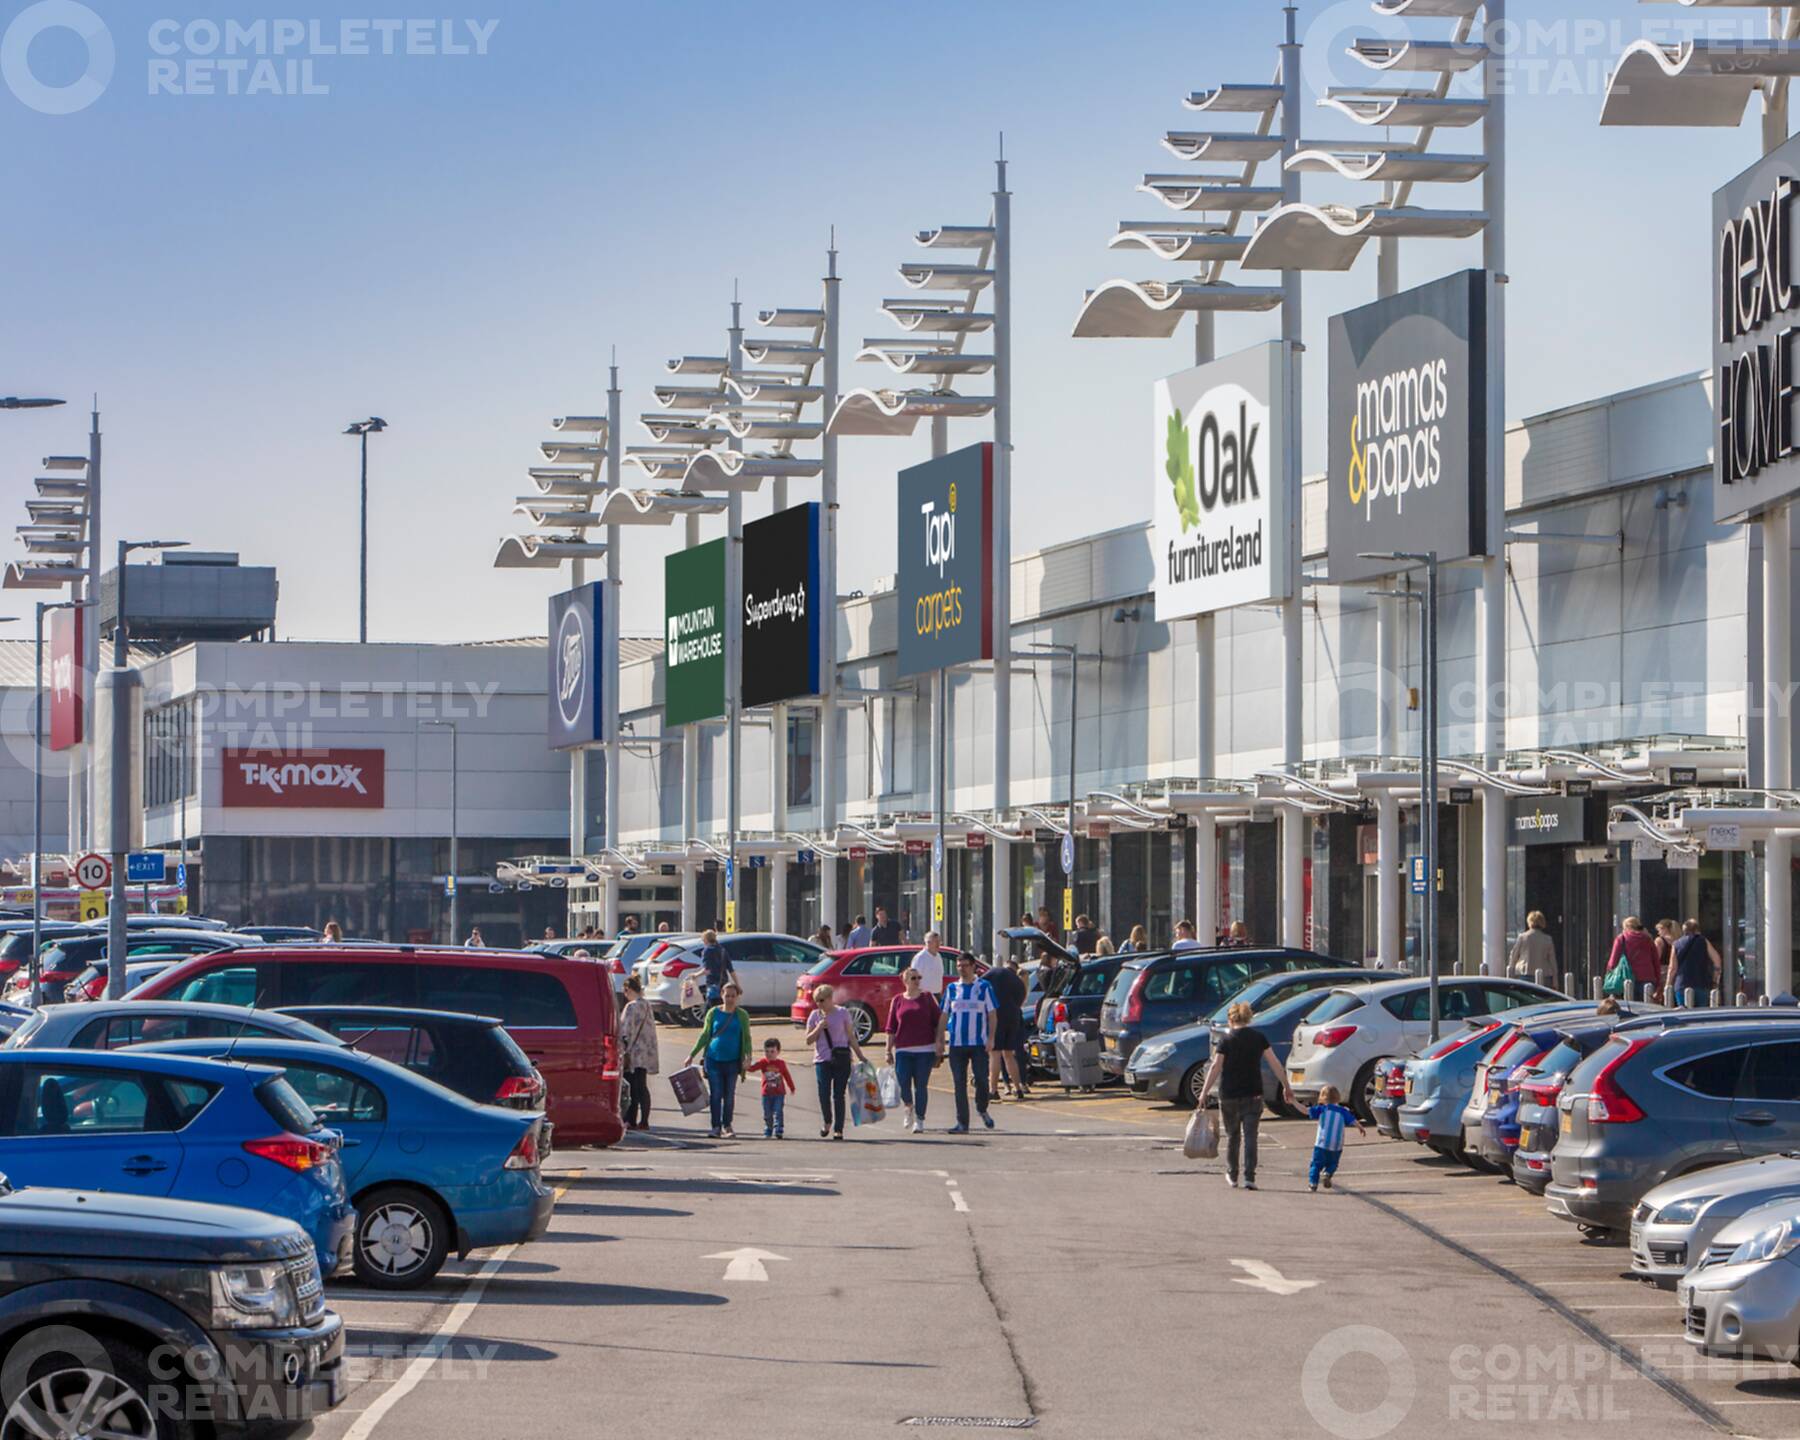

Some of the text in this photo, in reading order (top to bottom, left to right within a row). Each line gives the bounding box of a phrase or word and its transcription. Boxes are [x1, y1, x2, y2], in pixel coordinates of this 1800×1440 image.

[1720, 175, 1800, 343] next
[1356, 357, 1448, 441] mamas
[1199, 400, 1260, 513] Oak
[921, 482, 957, 579] Tapi
[1168, 519, 1262, 585] furnitureland
[677, 605, 716, 636] MOUNTAIN
[745, 588, 797, 630] Superdrug
[915, 579, 963, 640] carpets
[678, 632, 723, 664] WAREHOUSE
[82, 865, 103, 880] 10
[136, 863, 156, 871] EXIT
